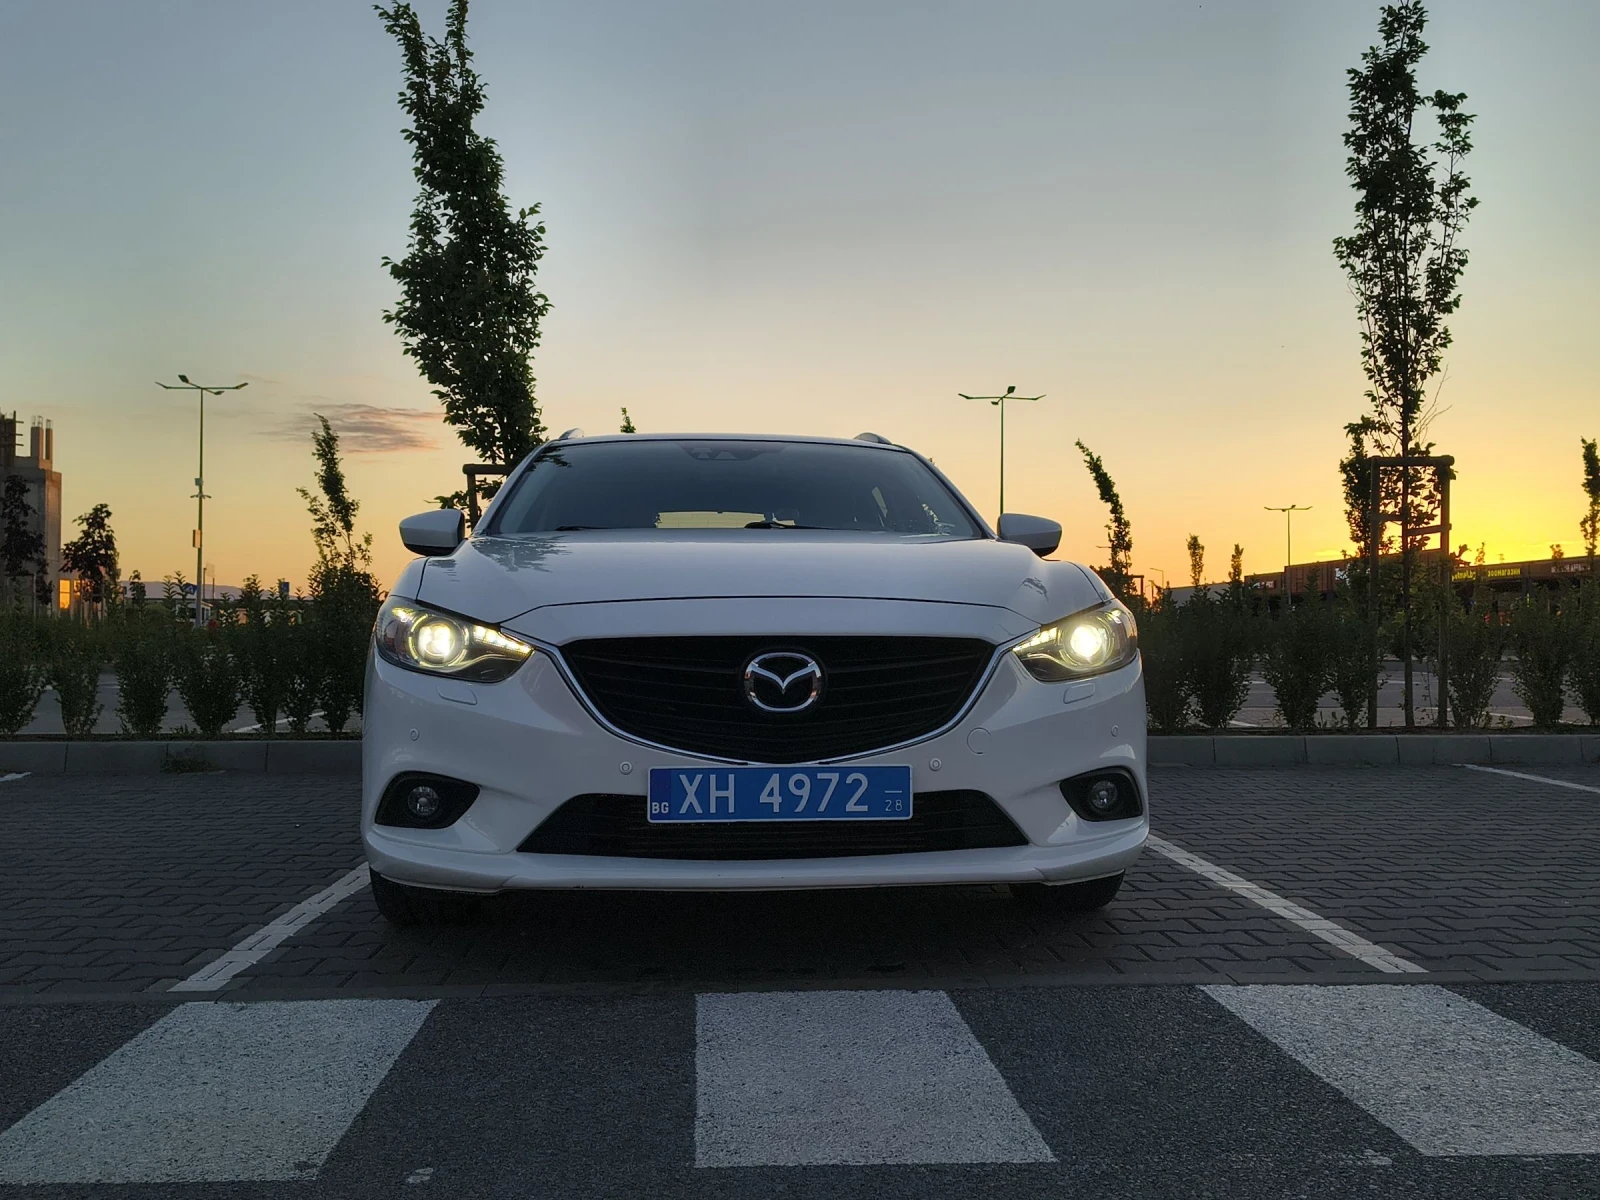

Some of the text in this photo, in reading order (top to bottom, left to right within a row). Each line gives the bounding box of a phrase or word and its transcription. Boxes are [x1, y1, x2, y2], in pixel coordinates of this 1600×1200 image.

[679, 772, 869, 814] XH 4972
[651, 802, 669, 814] BG
[885, 799, 903, 812] 28
